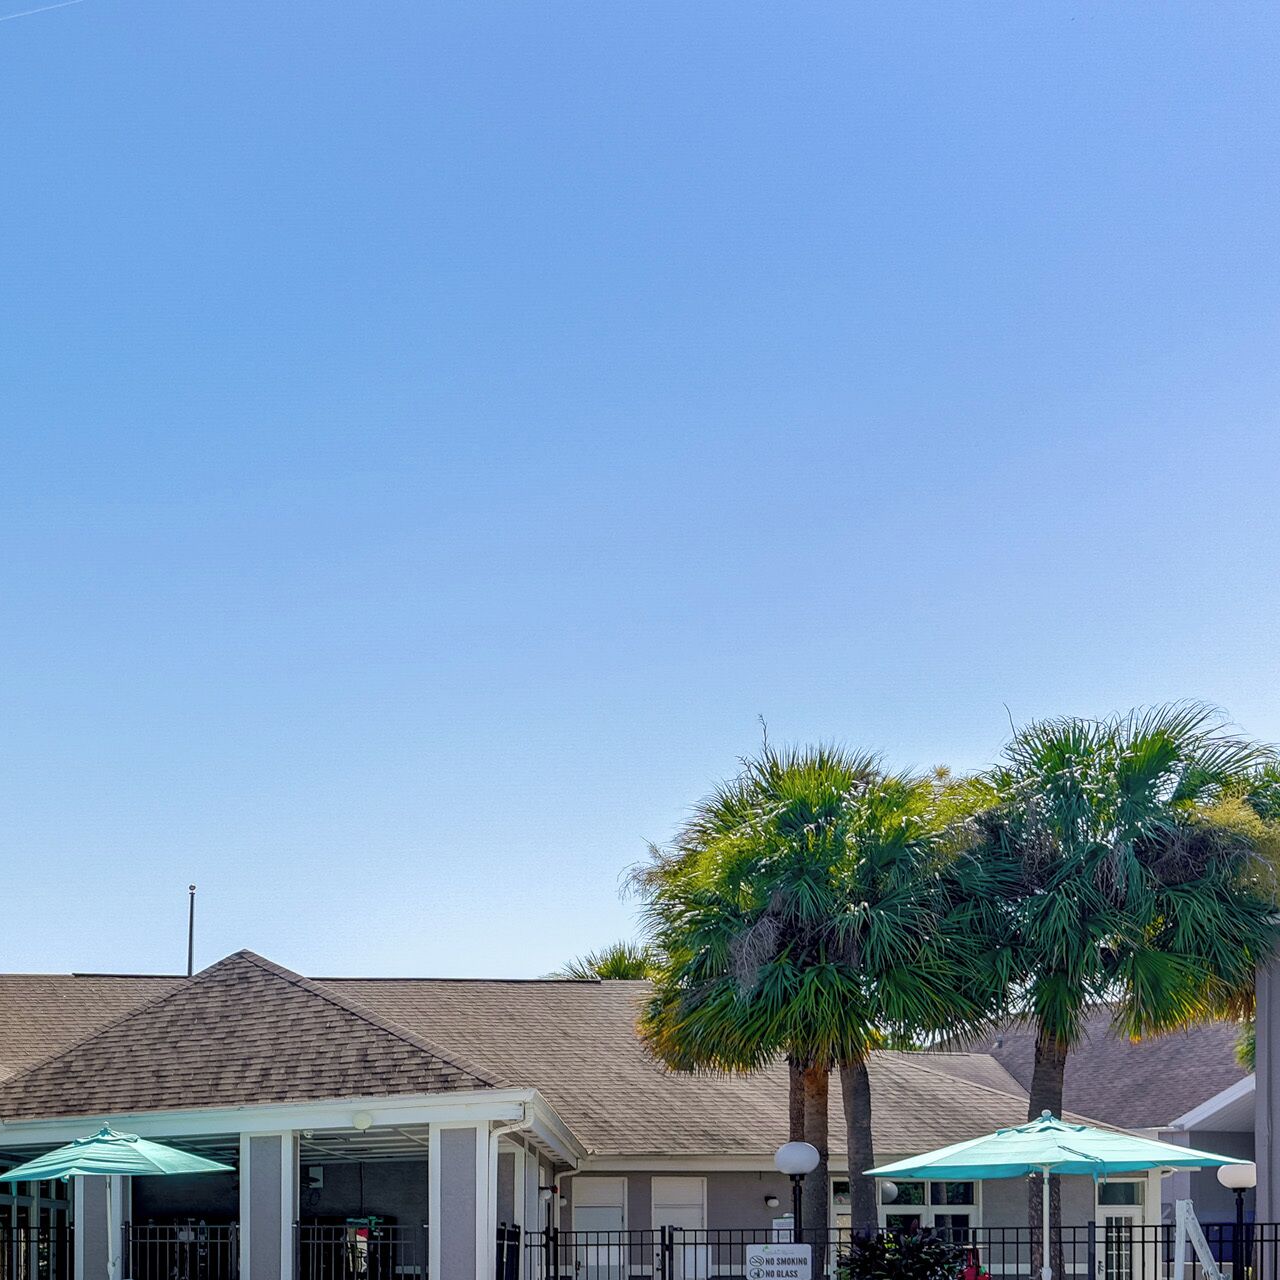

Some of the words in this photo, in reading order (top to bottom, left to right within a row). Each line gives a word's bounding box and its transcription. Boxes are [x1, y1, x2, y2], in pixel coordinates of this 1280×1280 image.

[765, 1258, 774, 1266] NO
[776, 1257, 808, 1266] SMOKING
[765, 1270, 774, 1278] NO
[776, 1270, 798, 1278] GLASS
